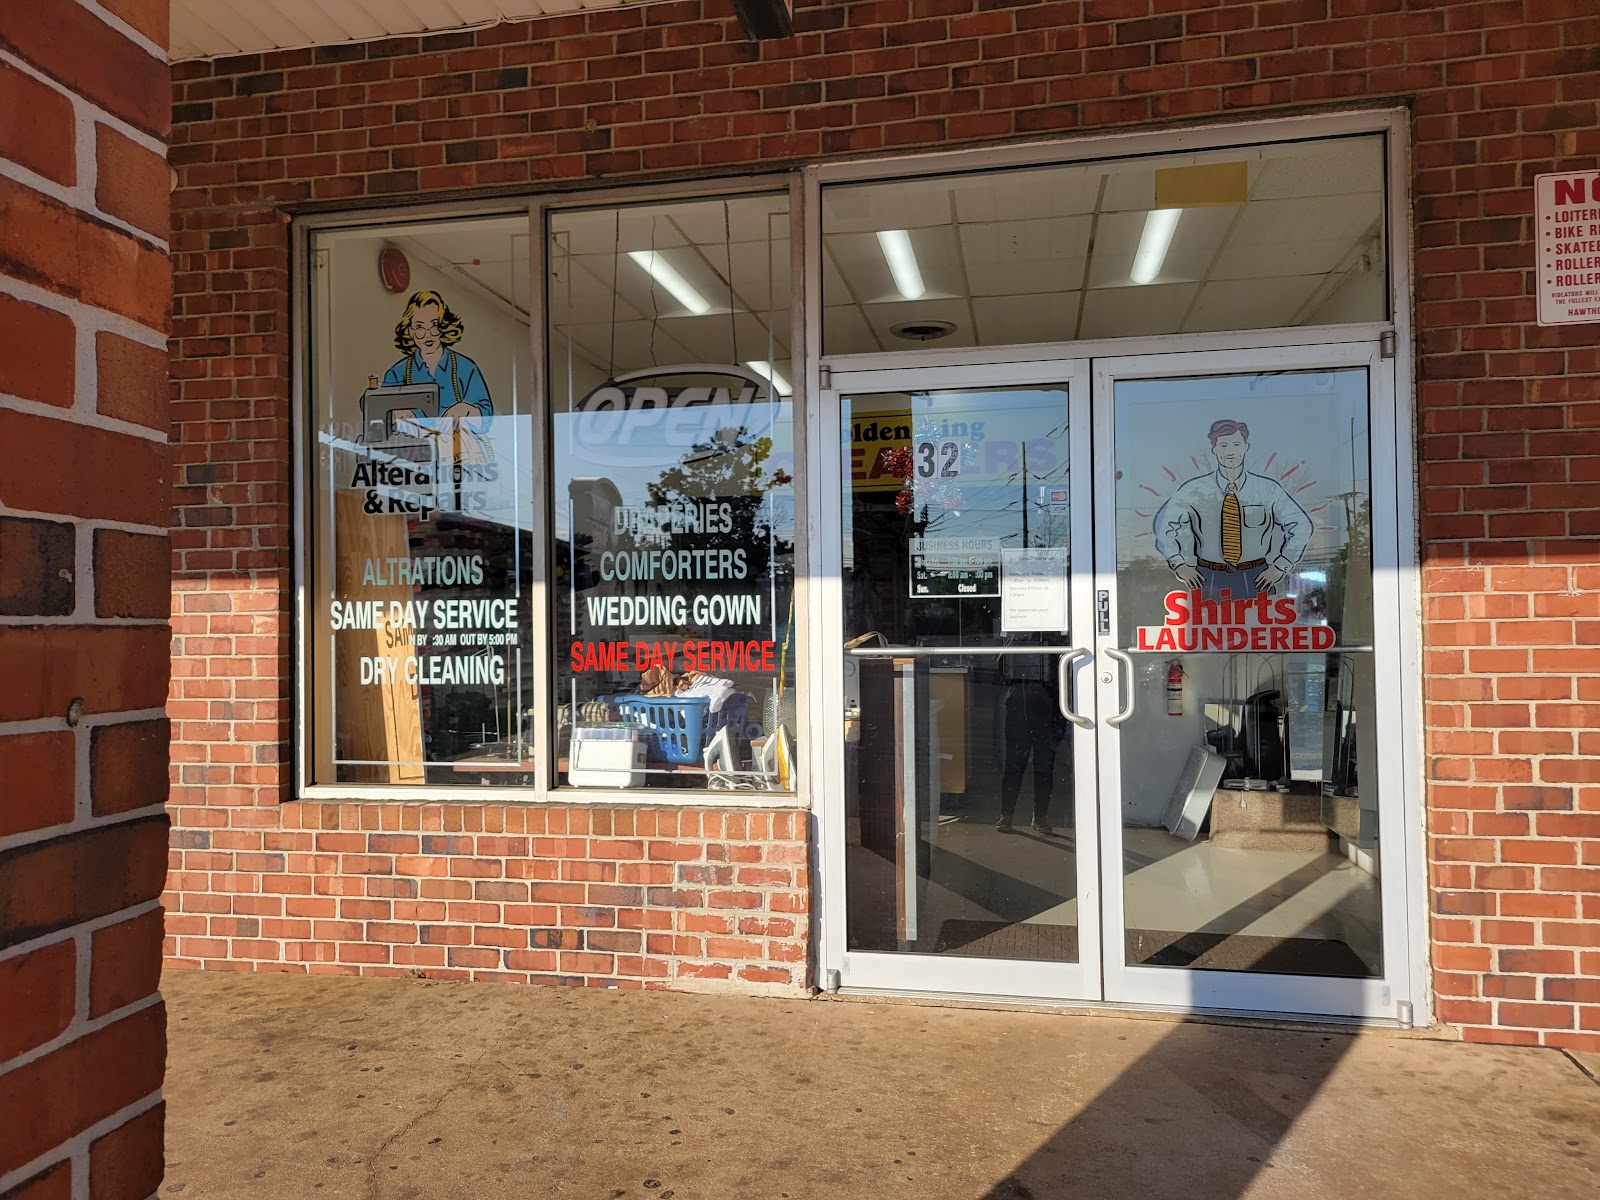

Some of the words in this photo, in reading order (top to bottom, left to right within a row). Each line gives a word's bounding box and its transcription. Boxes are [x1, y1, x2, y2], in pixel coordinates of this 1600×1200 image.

[1554, 176, 1600, 206] N
[1555, 225, 1583, 239] BIKE
[1556, 256, 1600, 271] ROLLER
[1552, 290, 1583, 298] VIOLATORS
[1556, 272, 1600, 287] ROLLER
[578, 386, 757, 446] OPEN
[842, 422, 911, 444] olden
[351, 457, 498, 488] Alterations
[917, 442, 960, 478] 32
[363, 489, 384, 514] &
[388, 487, 487, 521] Repairs
[614, 502, 733, 536] DRAPERIES
[916, 540, 960, 551] BUSINESS
[962, 539, 993, 550] HOURS
[363, 555, 484, 586] ALTRATIONS
[600, 548, 748, 582] COMFORTERS
[916, 570, 928, 579] Sat.
[984, 571, 993, 580] pm
[958, 583, 977, 593] Closed
[330, 600, 385, 630] SAME
[390, 600, 430, 629] DAY
[433, 599, 518, 630] SERVICE
[587, 594, 687, 626] WEDDING
[693, 594, 761, 626] GOWN
[1098, 591, 1110, 633] PULL
[1165, 588, 1297, 626] Shirts
[417, 633, 428, 646] BY
[445, 633, 457, 646] AM
[460, 633, 477, 646] OUT
[477, 633, 488, 646] BY
[489, 633, 504, 646] 5:00
[506, 633, 518, 646] PM
[1138, 627, 1335, 651] LAUNDERED
[360, 656, 399, 686] DRY
[404, 654, 505, 686] CLEANING
[570, 641, 629, 673] SAME
[635, 640, 678, 672] DAY
[683, 640, 775, 672] SERVICE
